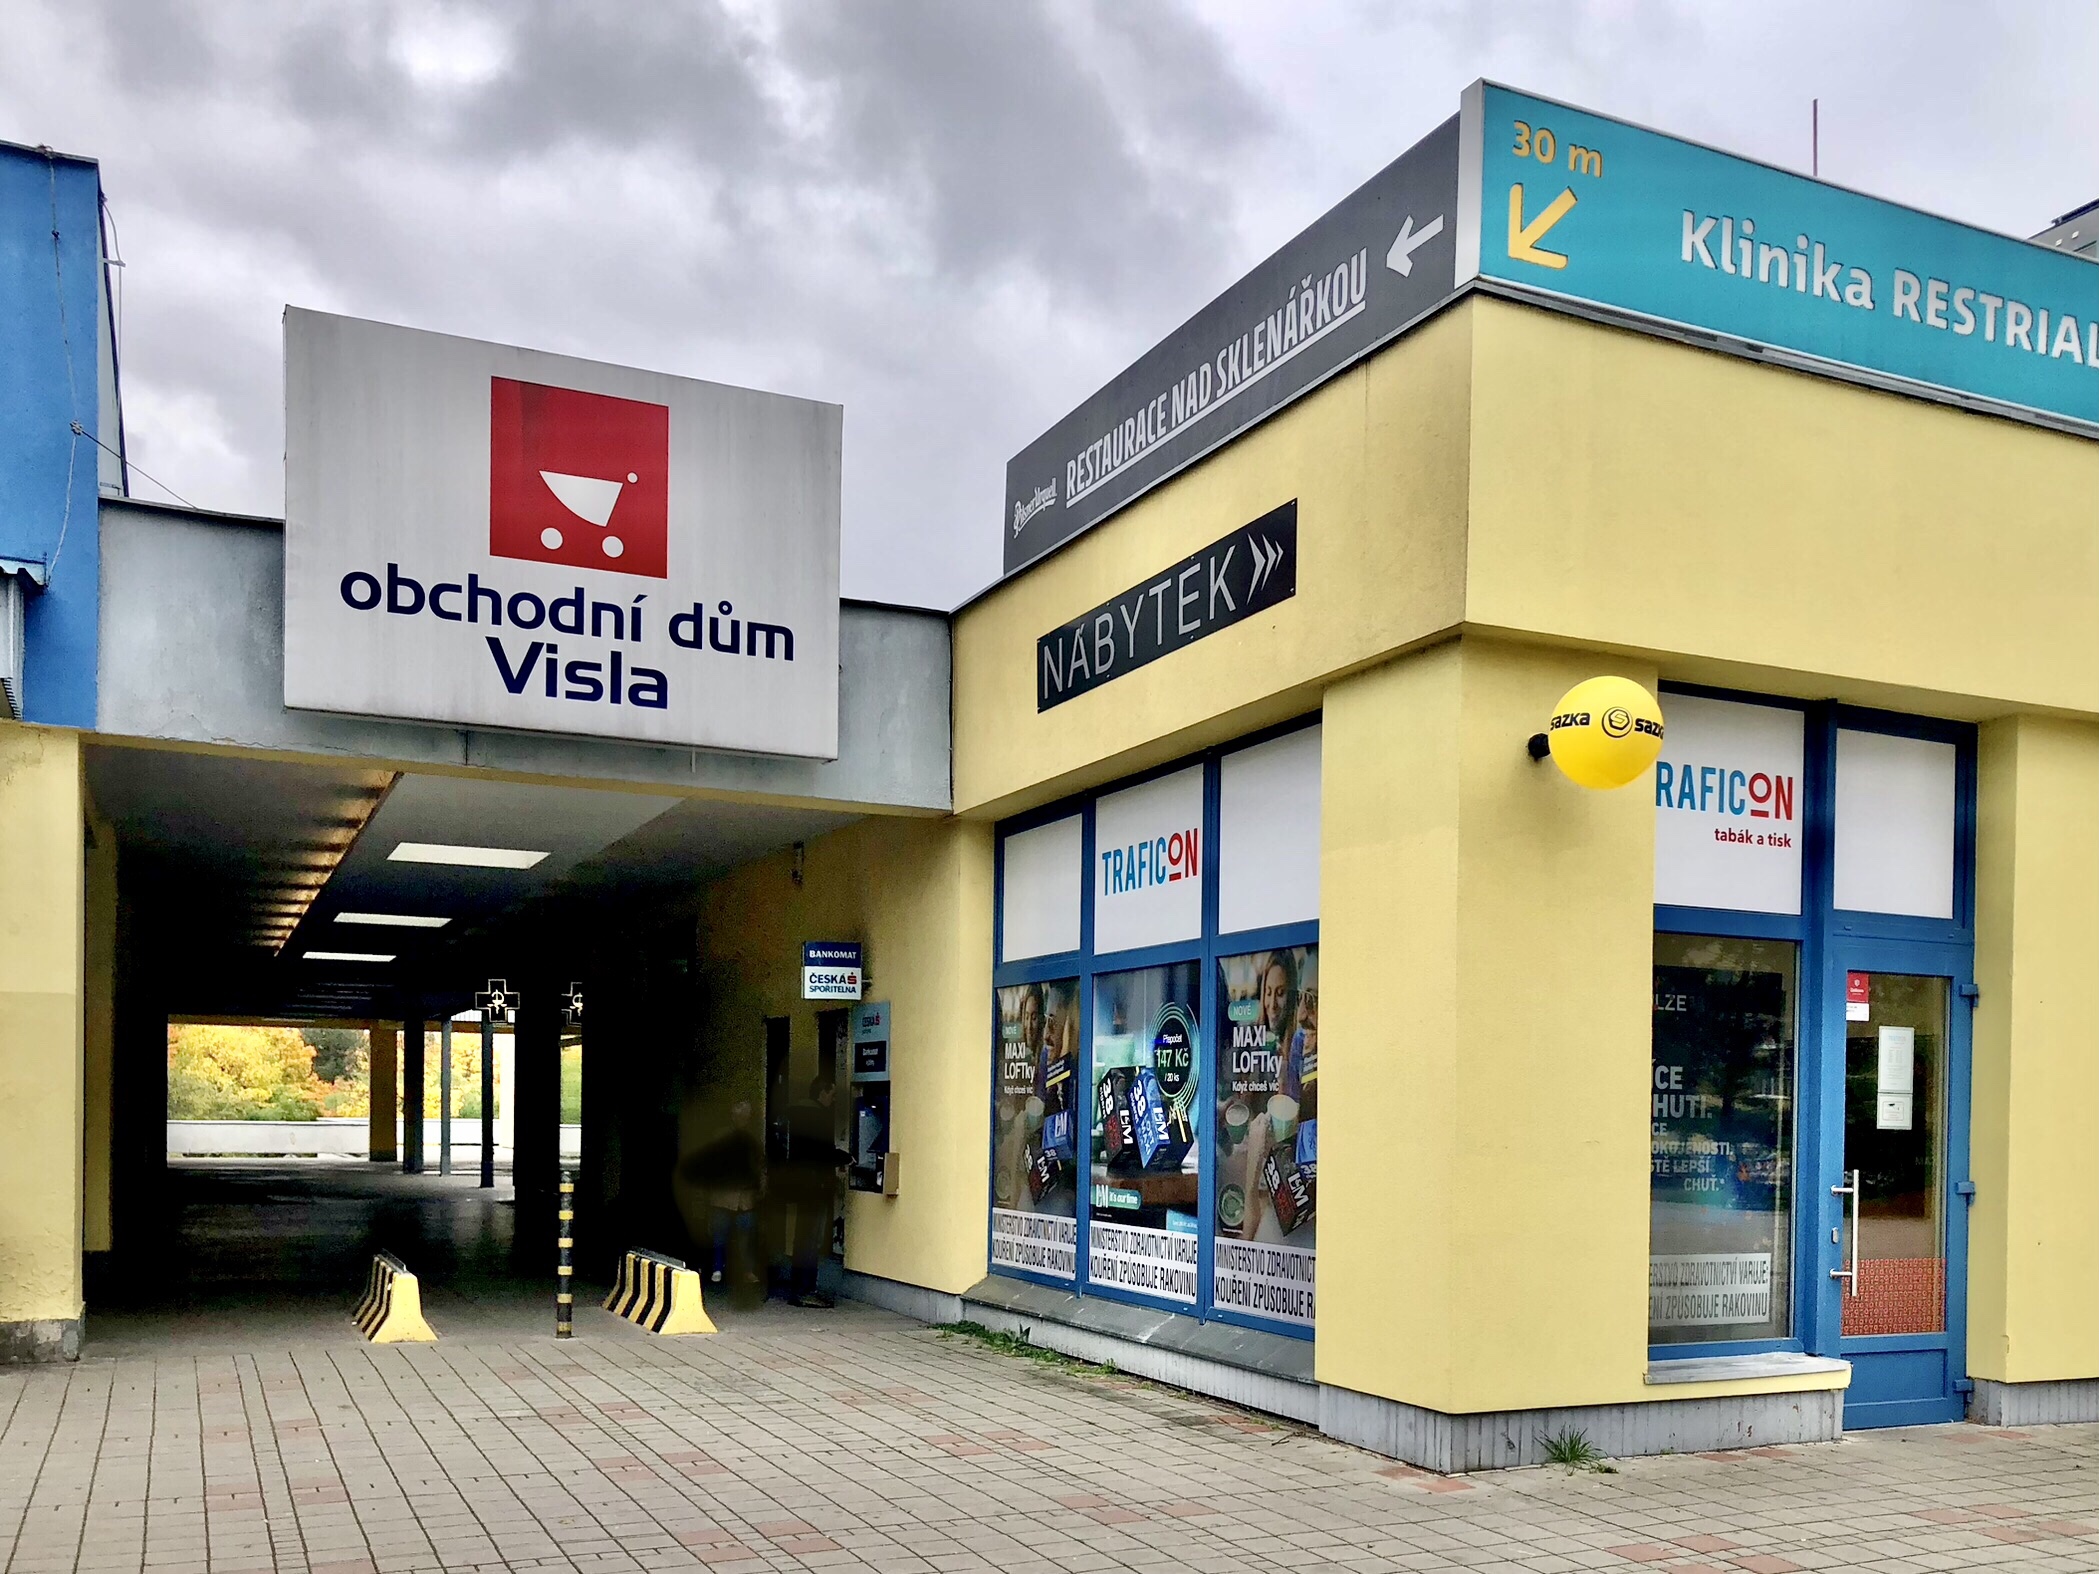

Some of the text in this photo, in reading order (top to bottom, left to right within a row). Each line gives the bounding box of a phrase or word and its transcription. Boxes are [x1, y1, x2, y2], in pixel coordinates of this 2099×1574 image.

[1511, 120, 1602, 177] 30 m
[1682, 208, 2099, 369] Klinika RESTRIAL
[1066, 247, 1367, 499] RESTAURACE NAD SKLENÁŘKOU
[340, 562, 794, 661] obchodní dům
[1043, 545, 1236, 700] NÁBYTEK
[485, 636, 668, 710] Visla
[1714, 827, 1791, 848] tabák a tisk
[1102, 828, 1198, 896] TRAFICON
[809, 950, 857, 959] BANKOMAT
[809, 972, 846, 984] ČESKÁ
[809, 984, 856, 993] SPOŘITELNA
[1233, 1003, 1252, 1016] NOVÉ
[1651, 993, 1687, 1012] LZE
[1005, 1042, 1026, 1060] MAXI
[1233, 1025, 1266, 1048] MAXI
[1005, 1062, 1035, 1083] LOFTky
[1156, 1048, 1189, 1068] 147 Kč
[1232, 1051, 1283, 1078] LOFTky
[1134, 1079, 1146, 1117] 38
[1232, 1080, 1280, 1093] Když chceš víc
[1216, 1243, 1264, 1276] MINISTERSTVO
[1680, 1256, 1738, 1287] ZDRAVOTNICTVÍ
[1119, 1257, 1158, 1289] ZPŮSOBUJE
[1160, 1266, 1197, 1297] RAKOVINU
[1215, 1275, 1252, 1308] KOUŘENÍ
[1253, 1279, 1304, 1319] ZPŮSOBUJE
[1665, 1288, 1719, 1320] ZPŮSOBUJE
[1722, 1293, 1768, 1318] RAKOVINU
